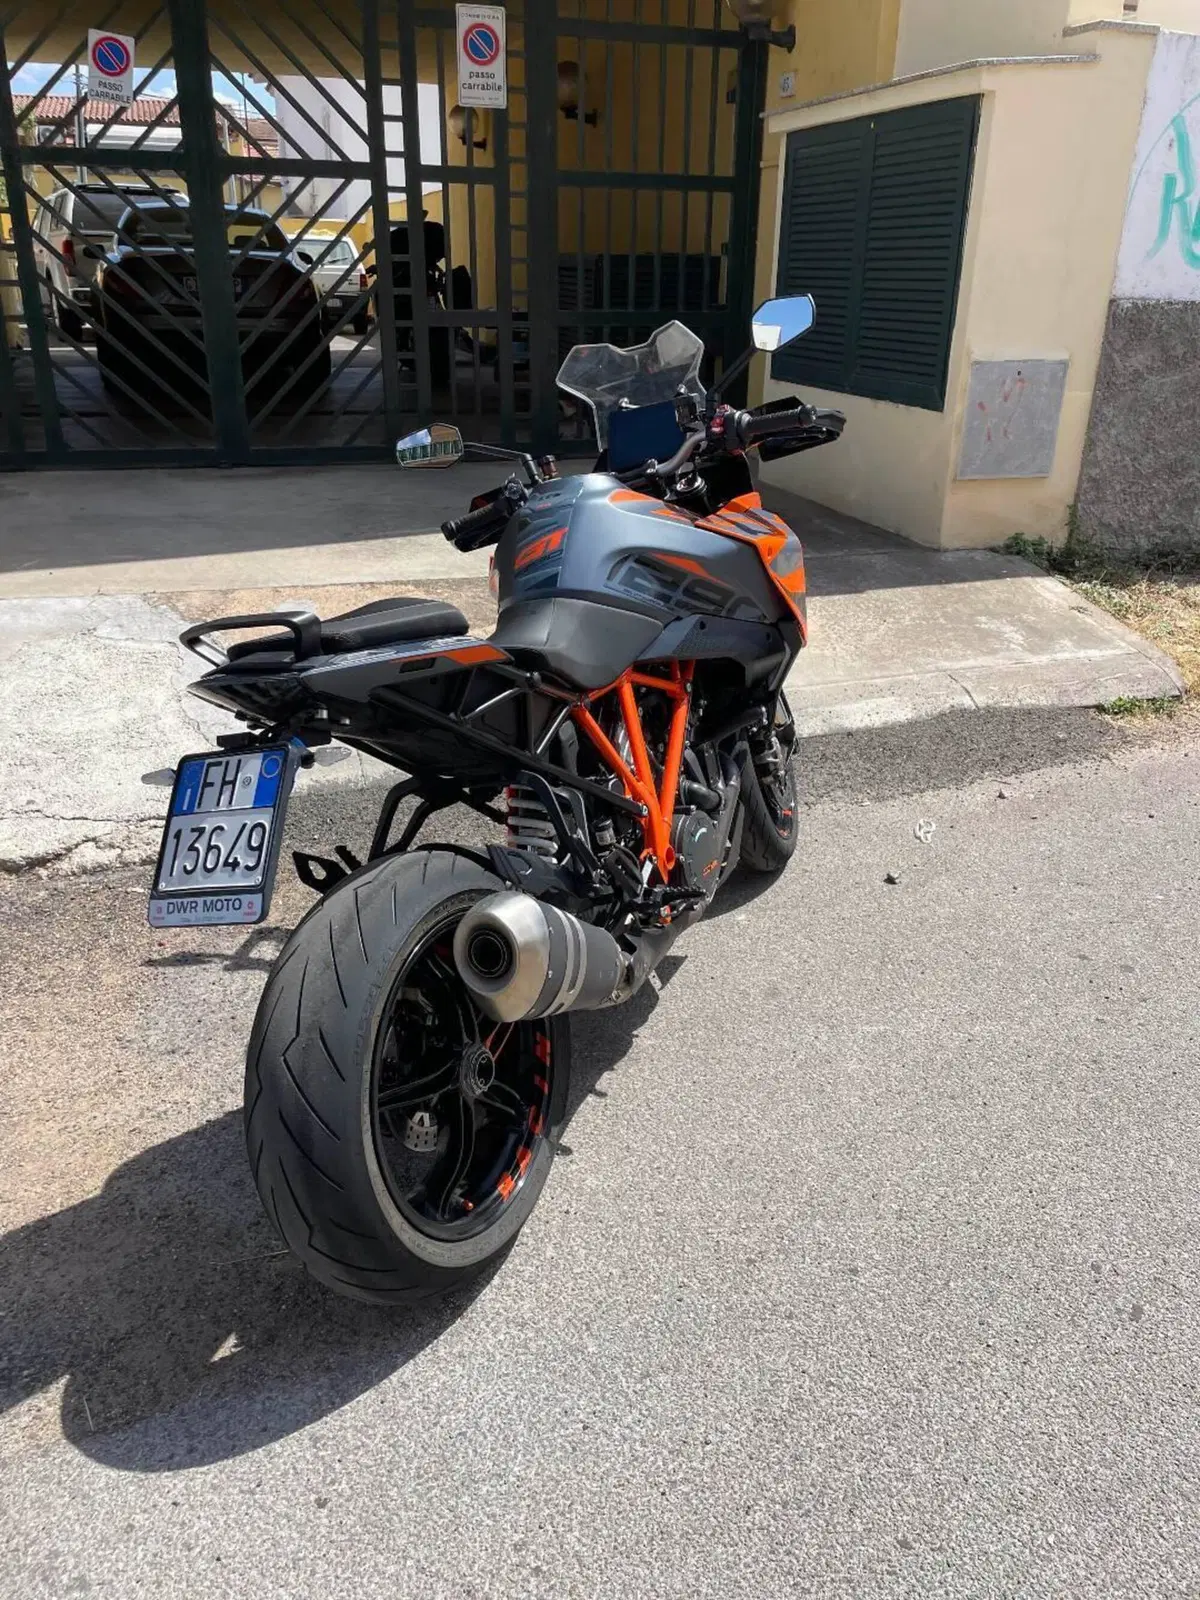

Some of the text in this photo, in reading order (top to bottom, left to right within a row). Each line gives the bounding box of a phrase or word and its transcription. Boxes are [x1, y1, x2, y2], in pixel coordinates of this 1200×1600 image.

[469, 71, 496, 79] passo
[98, 80, 123, 92] PASSO
[462, 82, 503, 92] carrabile
[90, 89, 131, 104] CARRABILE
[197, 758, 242, 809] FH
[169, 821, 268, 878] 13649
[166, 897, 242, 915] DWR MOTO
